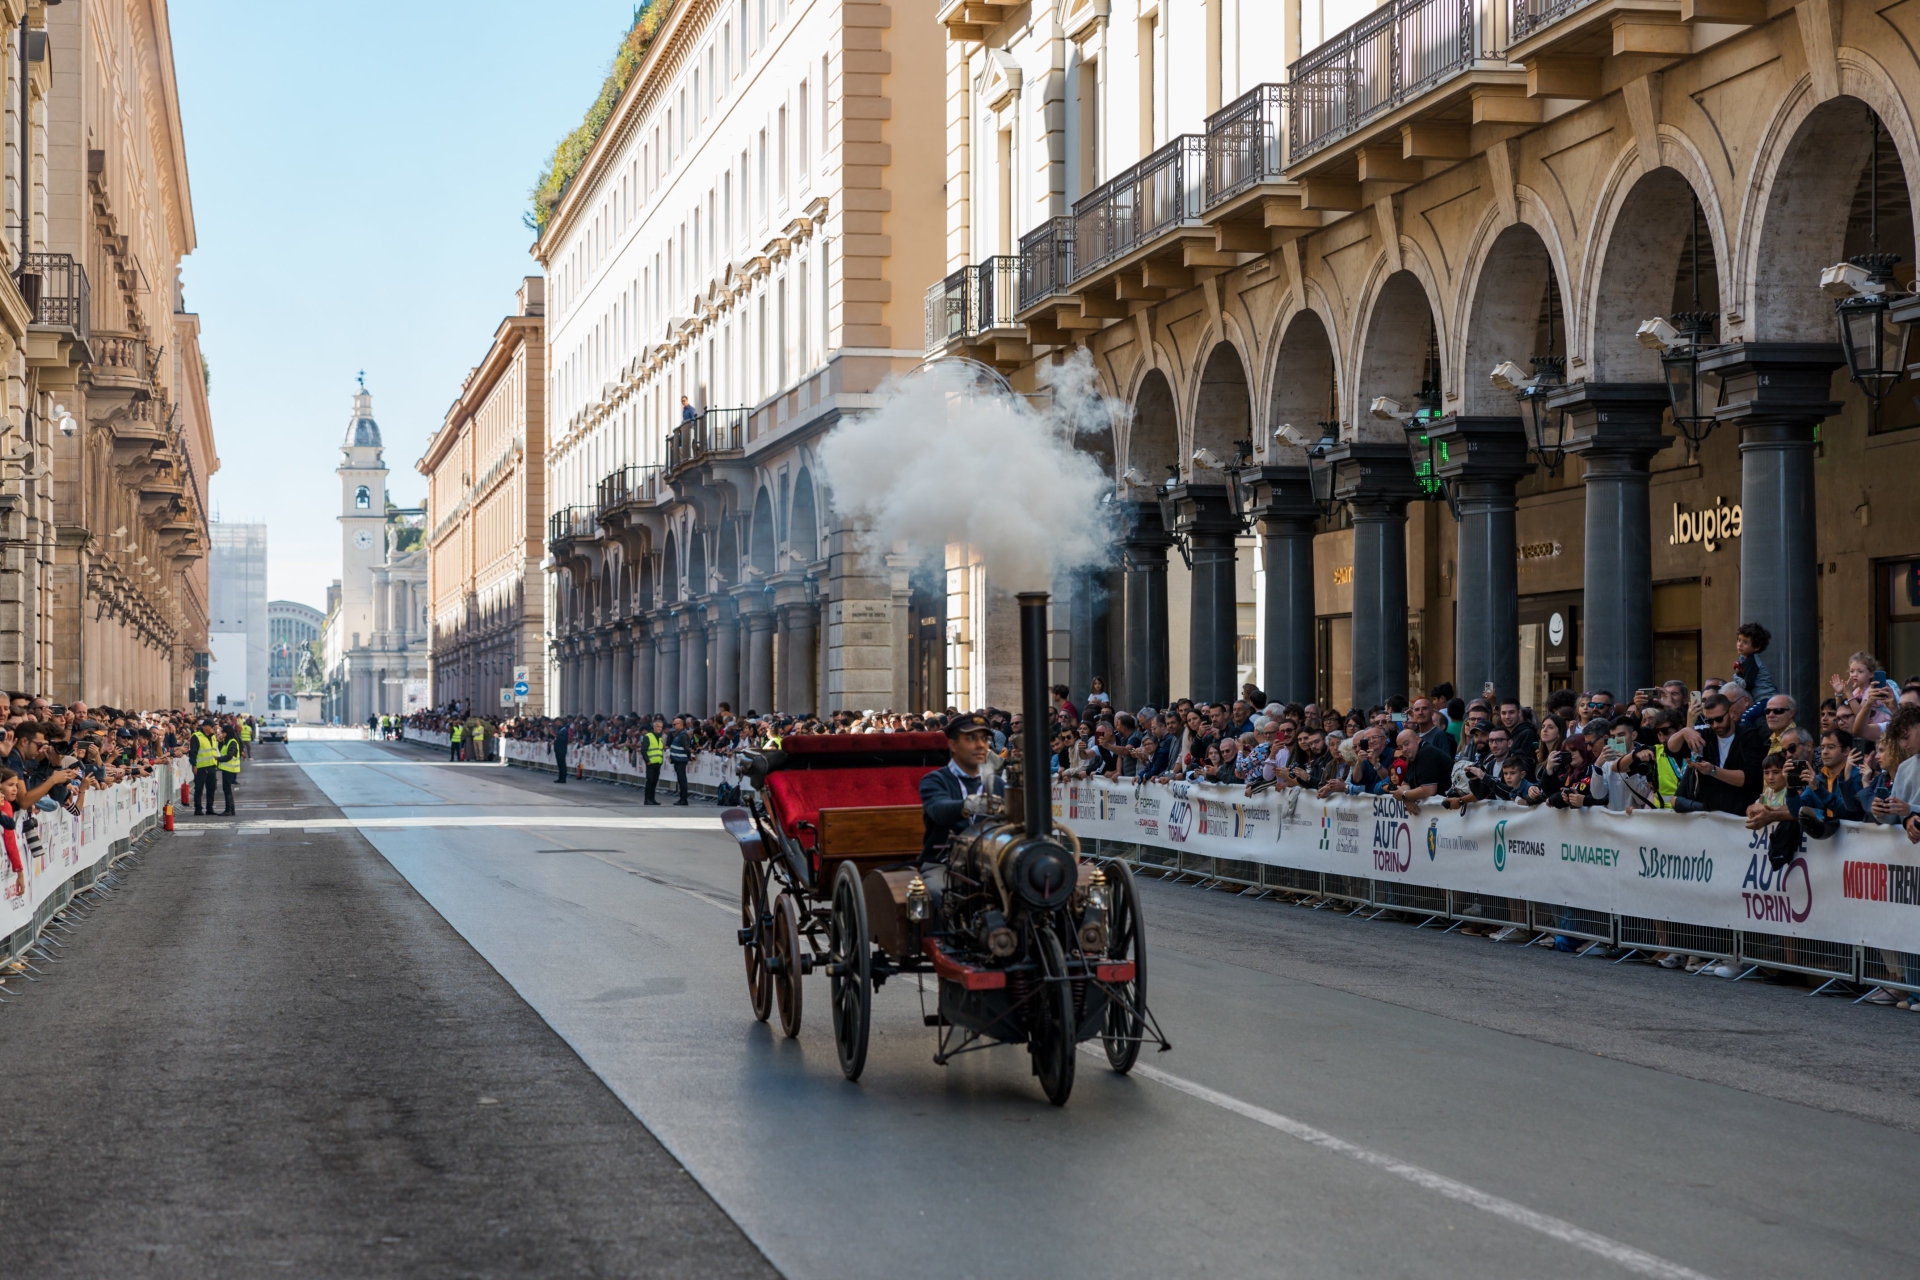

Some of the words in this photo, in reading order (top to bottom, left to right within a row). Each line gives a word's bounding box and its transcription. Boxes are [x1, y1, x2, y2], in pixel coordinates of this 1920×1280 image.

[1758, 376, 1770, 386] 14
[1598, 412, 1608, 422] 16
[1468, 442, 1478, 451] 18
[1360, 466, 1372, 475] 20
[1271, 487, 1282, 495] 22
[1373, 797, 1409, 819] SALONE
[1373, 820, 1411, 850] AUTO
[1508, 839, 1545, 857] PETRONAS
[1561, 843, 1620, 867] DUMAREY
[1843, 860, 1920, 906] MOTORTREN
